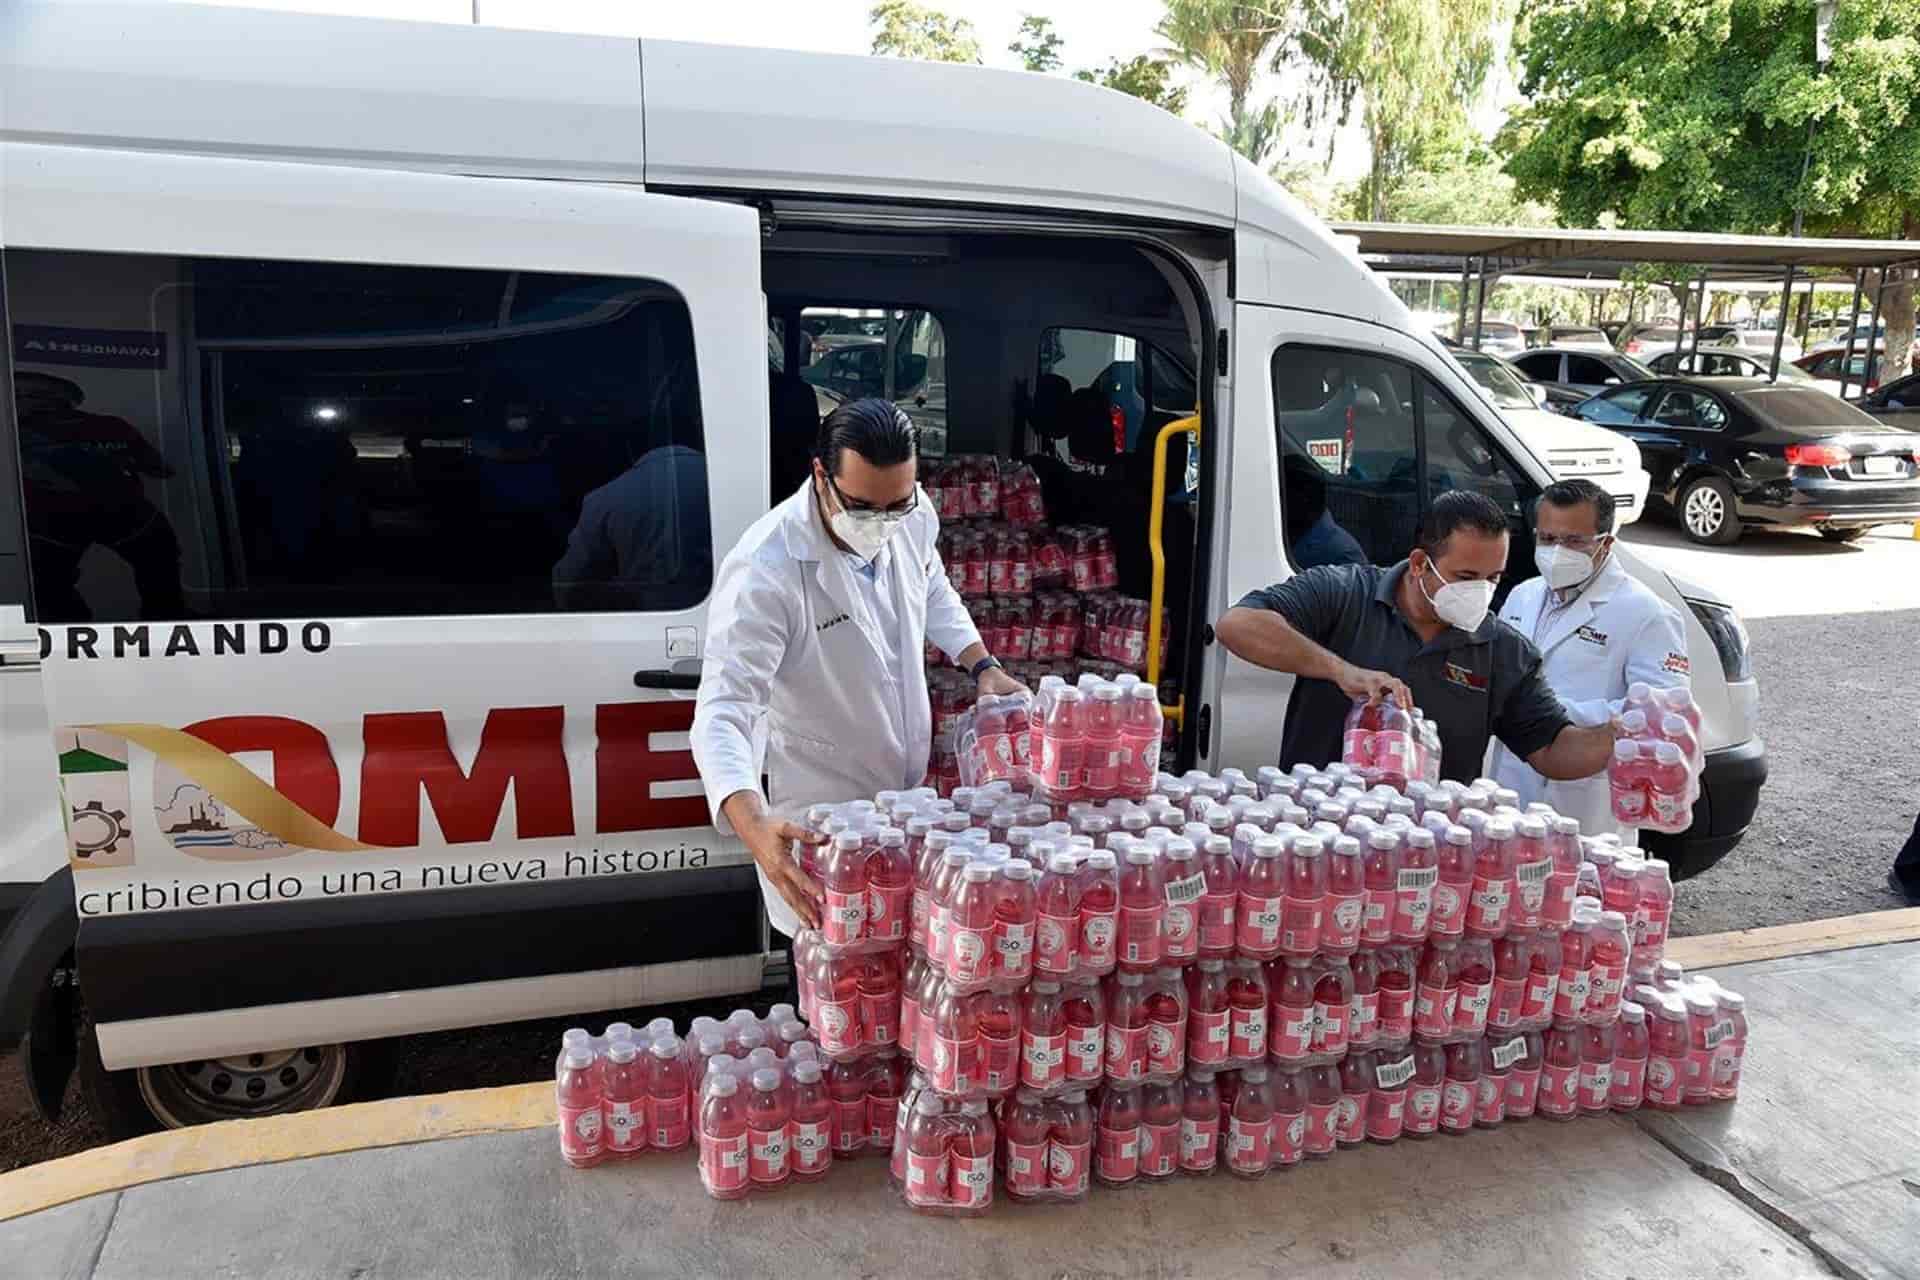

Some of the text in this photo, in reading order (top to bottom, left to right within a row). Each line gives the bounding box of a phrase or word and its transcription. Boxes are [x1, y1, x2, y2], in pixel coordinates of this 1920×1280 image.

[79, 843, 709, 915] cribiendo una nueva historia
